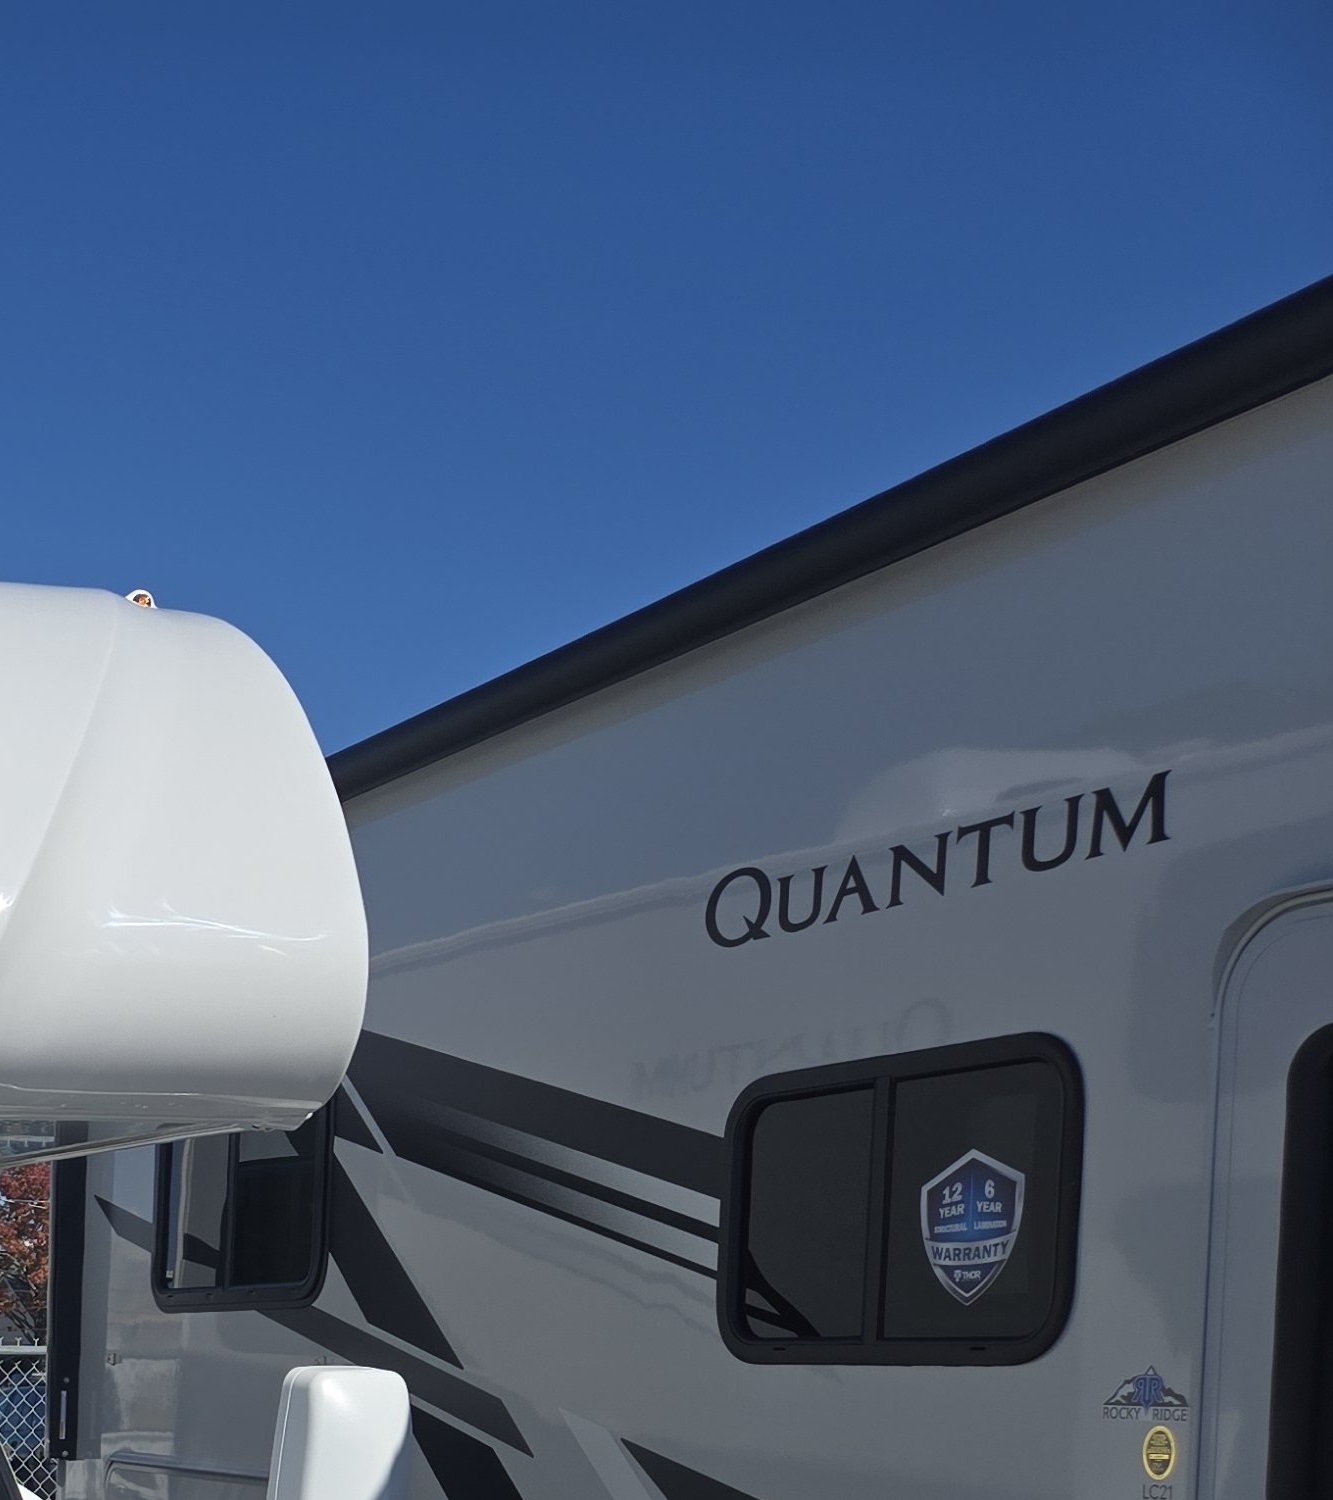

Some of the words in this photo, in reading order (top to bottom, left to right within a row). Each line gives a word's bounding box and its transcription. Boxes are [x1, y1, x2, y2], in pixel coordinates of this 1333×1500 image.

[705, 769, 1172, 948] QUANTUM
[942, 1182, 963, 1204] 12
[984, 1179, 995, 1199] 6
[939, 1203, 965, 1219] YEAR
[976, 1201, 1002, 1213] YEAR
[931, 1240, 1009, 1261] WARRANTY
[962, 1270, 981, 1280] THOR
[1102, 1406, 1141, 1420] ROCKY
[1152, 1408, 1187, 1421] RIDGE
[1142, 1484, 1173, 1500] LC21
